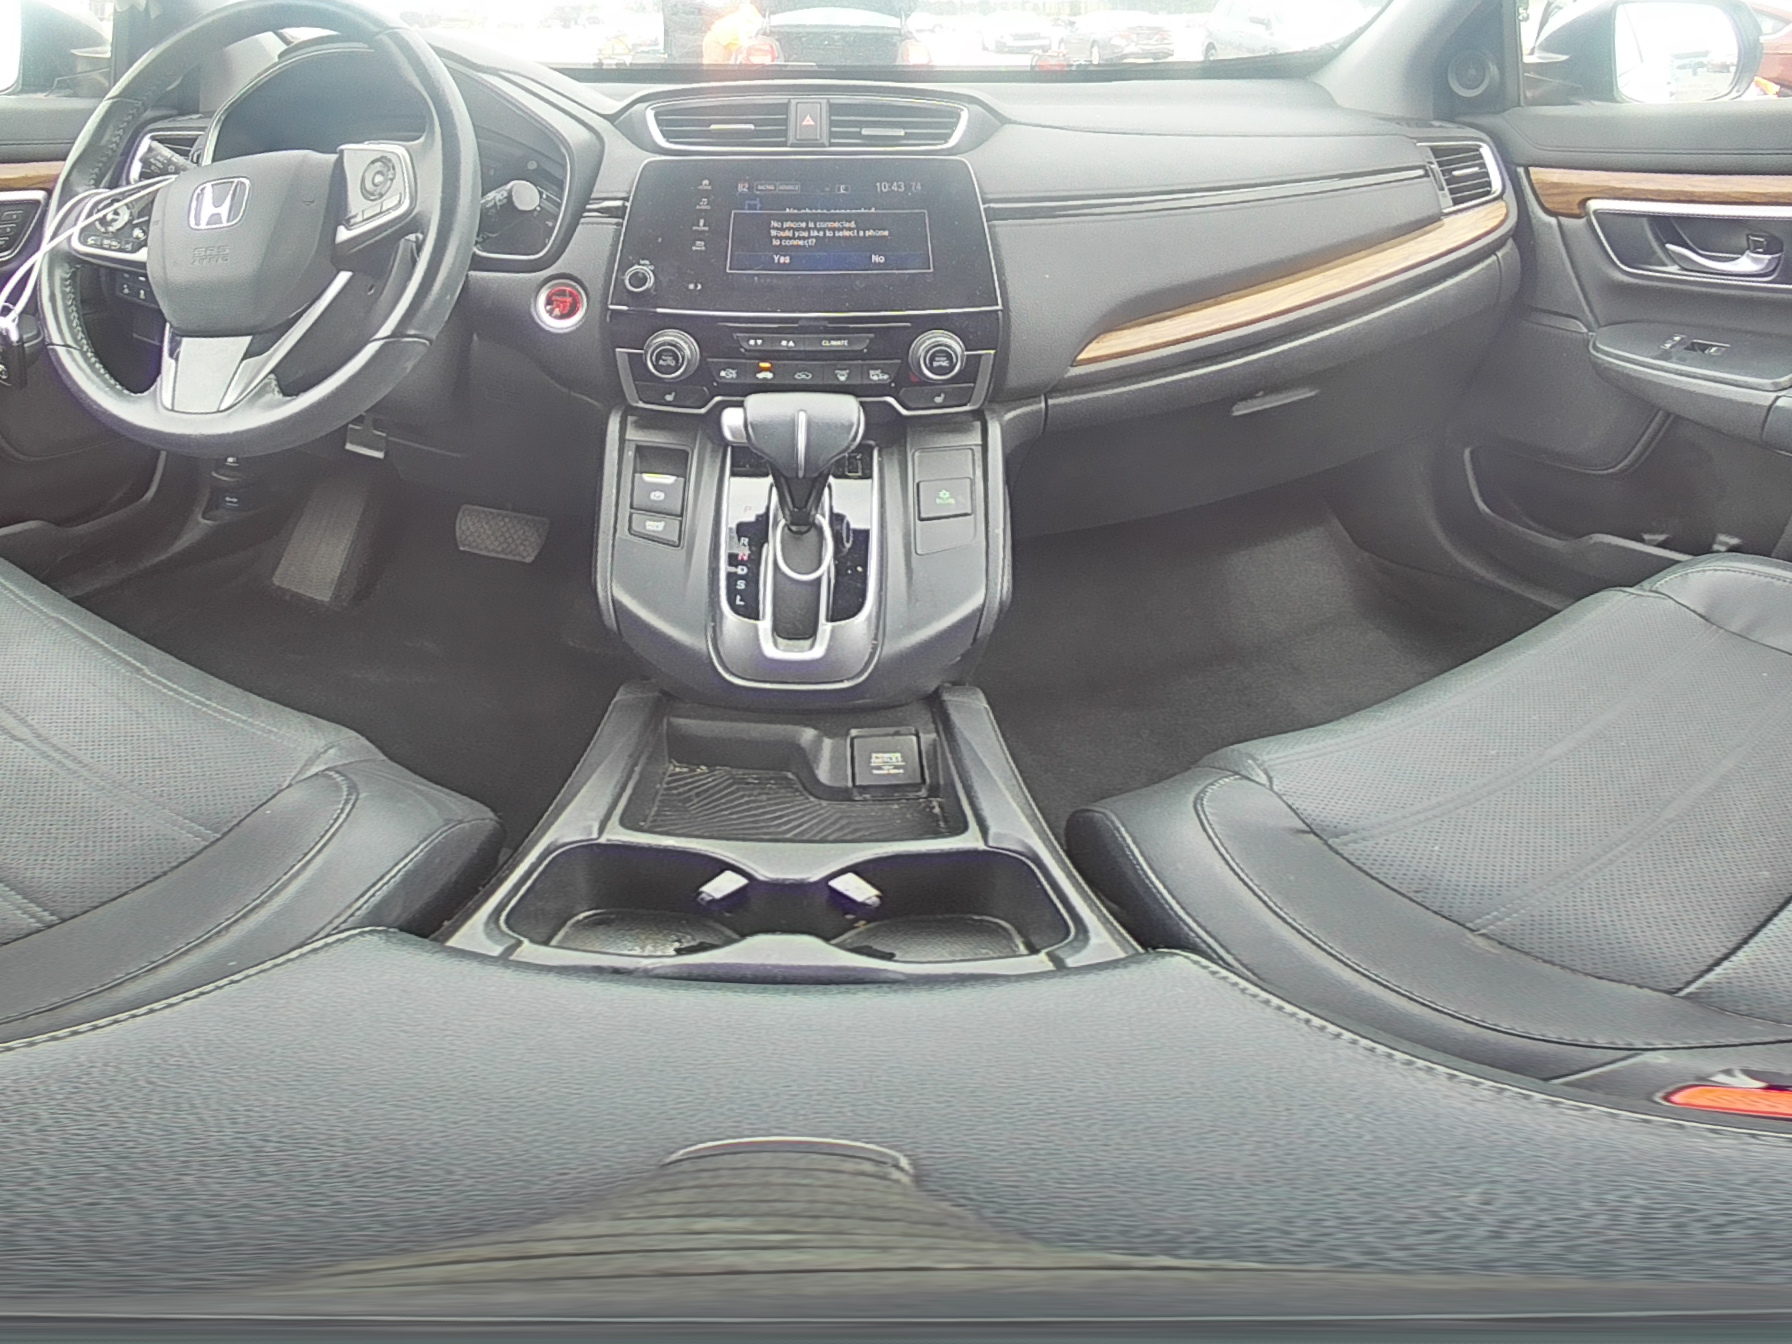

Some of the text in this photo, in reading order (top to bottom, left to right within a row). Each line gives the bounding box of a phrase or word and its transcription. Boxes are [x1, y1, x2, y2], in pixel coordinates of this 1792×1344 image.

[875, 181, 905, 193] 10:43
[770, 220, 782, 228] No
[772, 238, 780, 246] to
[773, 254, 791, 264] Yes
[871, 254, 885, 263] No
[739, 537, 749, 546] R
[737, 565, 748, 575] D
[735, 580, 746, 590] S
[735, 594, 745, 606] L
